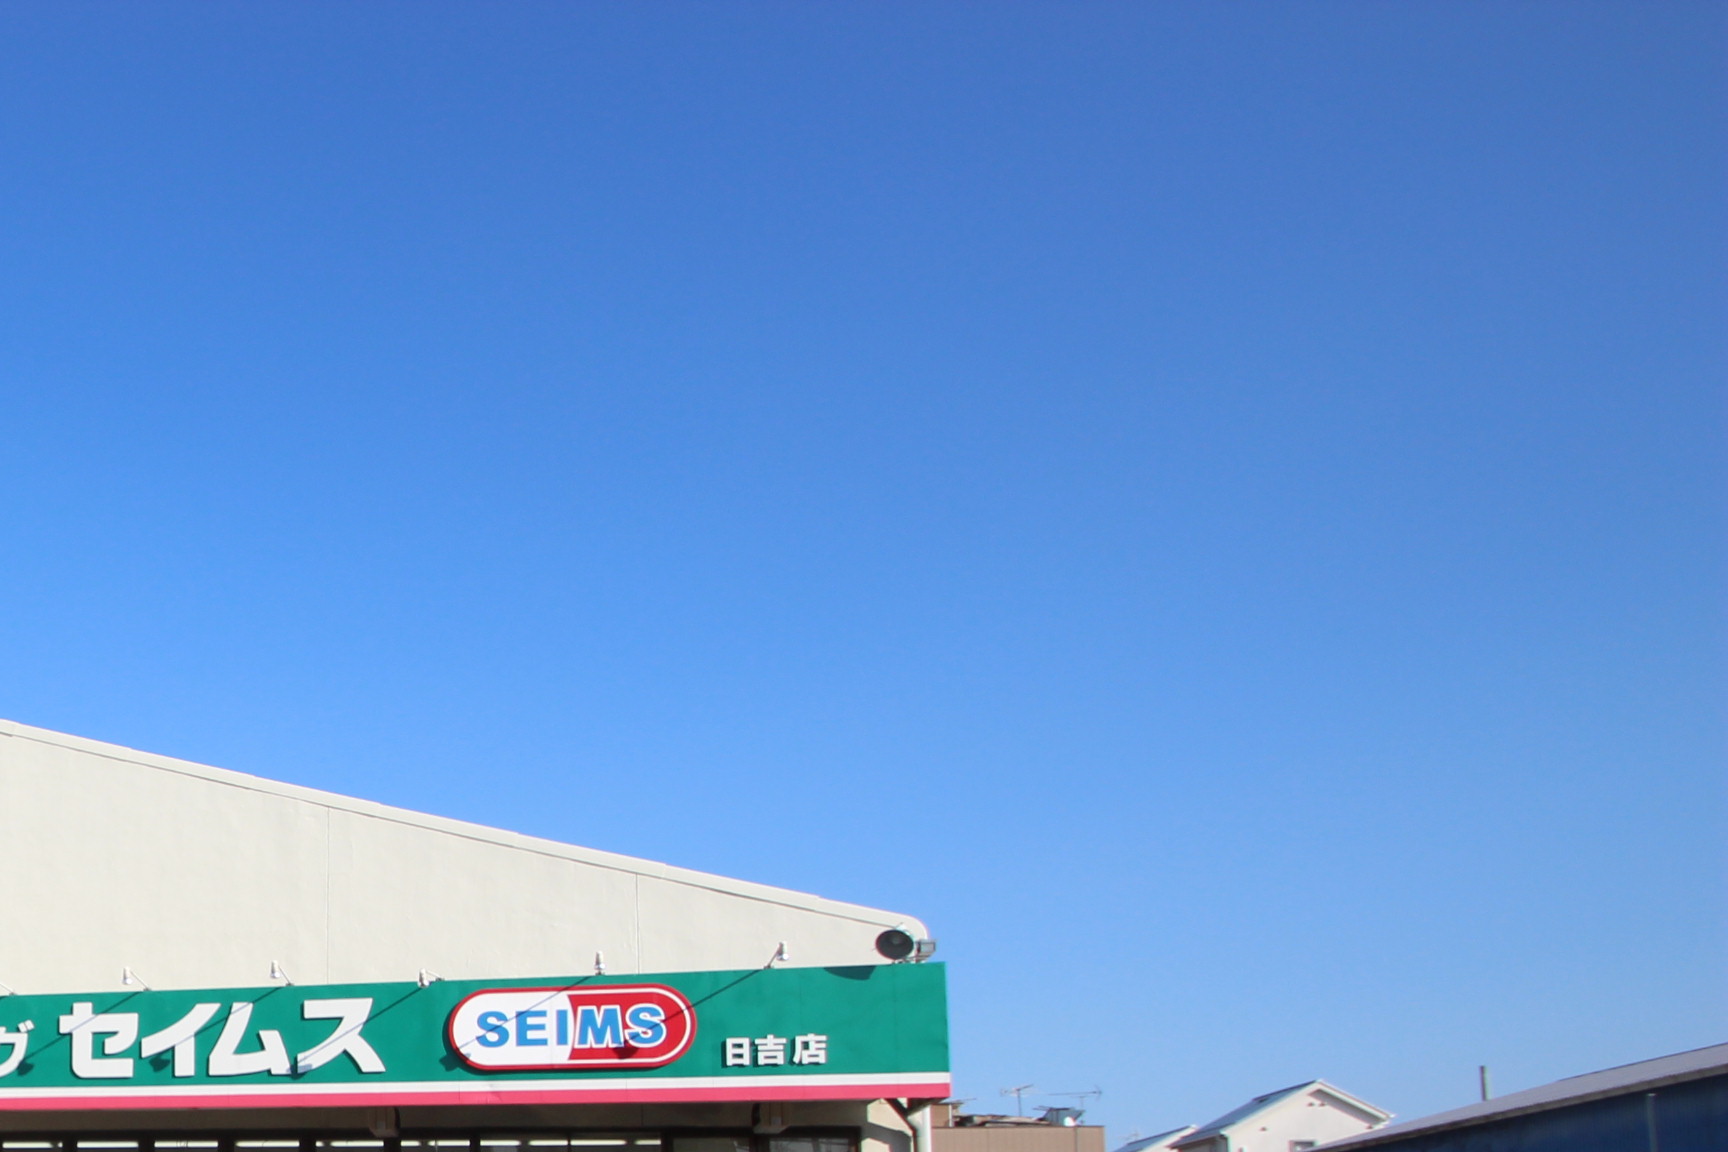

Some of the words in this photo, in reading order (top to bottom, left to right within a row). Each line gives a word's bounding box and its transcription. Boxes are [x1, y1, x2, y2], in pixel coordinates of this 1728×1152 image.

[58, 997, 387, 1079] セイムス
[475, 1003, 667, 1049] SEIMS
[724, 1033, 829, 1067] 日吉店
